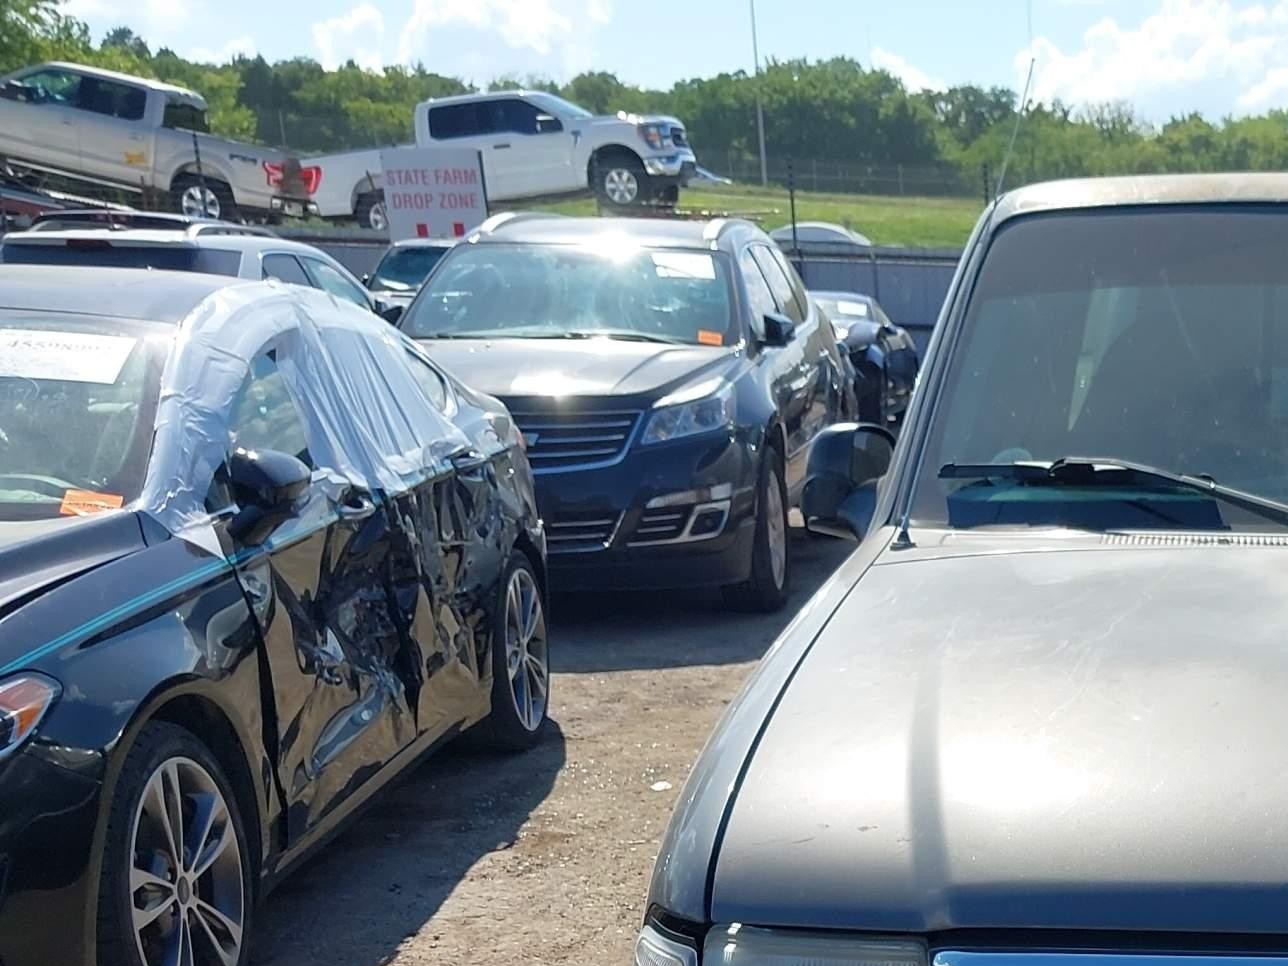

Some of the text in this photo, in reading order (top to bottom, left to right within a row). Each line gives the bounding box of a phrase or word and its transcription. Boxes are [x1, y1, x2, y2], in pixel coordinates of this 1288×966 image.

[386, 167, 477, 186] STATE FARM
[391, 191, 477, 209] DROP ZONE
